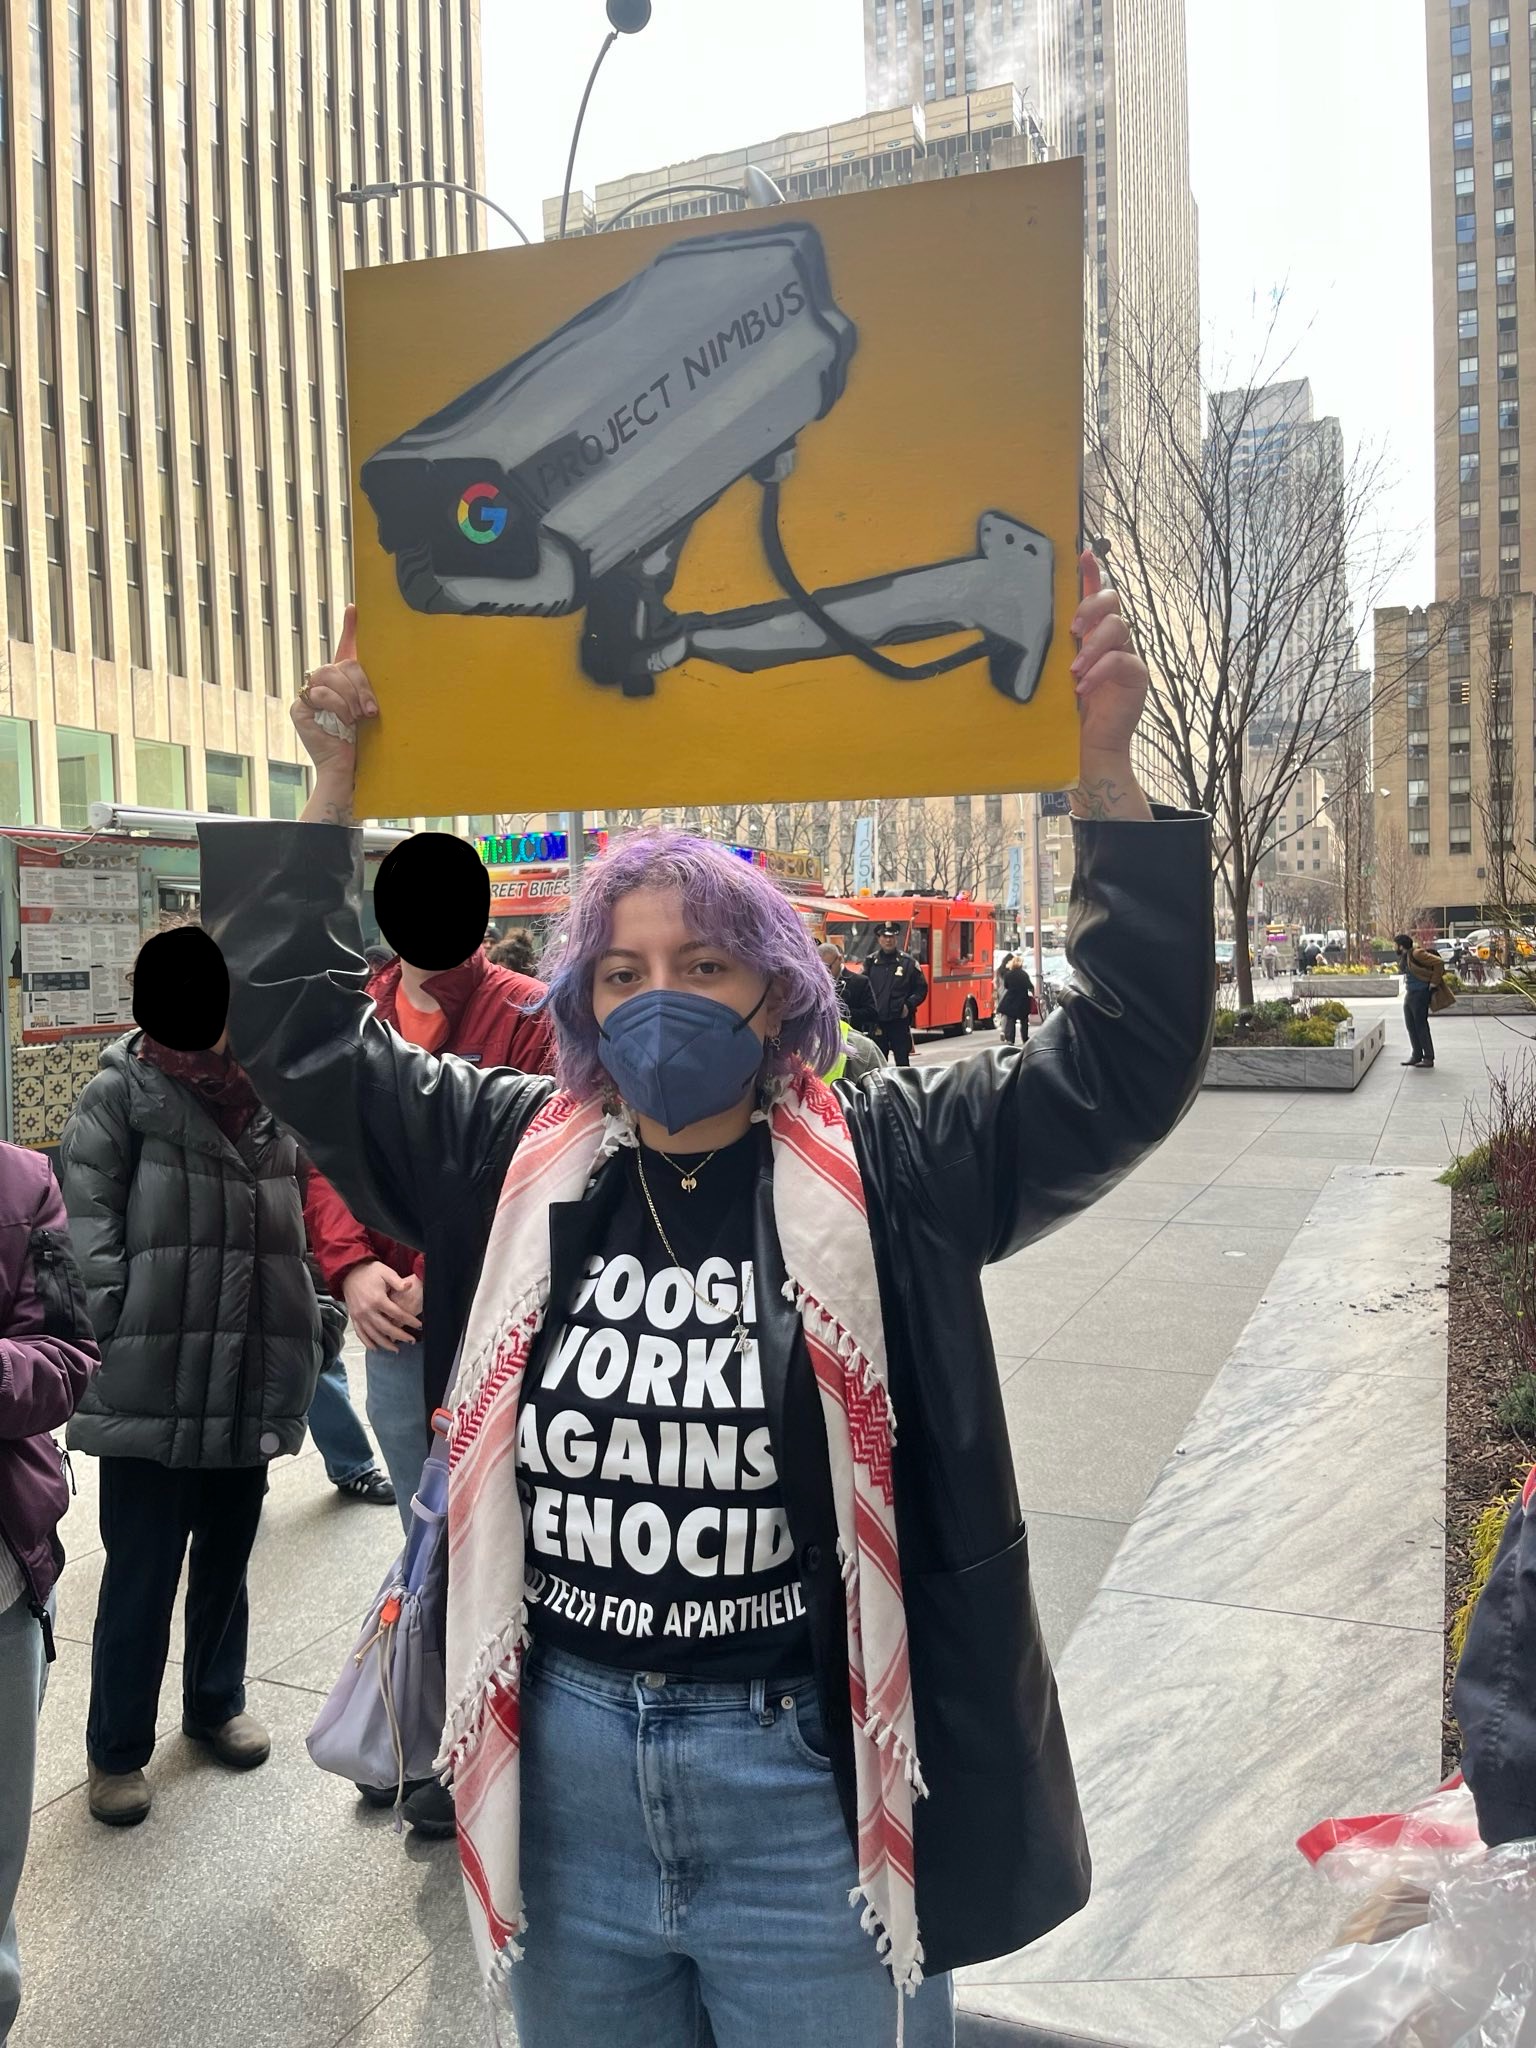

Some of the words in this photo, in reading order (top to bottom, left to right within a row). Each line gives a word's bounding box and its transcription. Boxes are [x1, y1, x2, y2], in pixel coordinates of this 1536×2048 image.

[537, 373, 671, 493] PROJECT
[682, 281, 805, 391] NIMBUS
[457, 482, 508, 545] G
[529, 880, 571, 896] BITES
[543, 1573, 596, 1627] TECH
[601, 1595, 654, 1638] FOR
